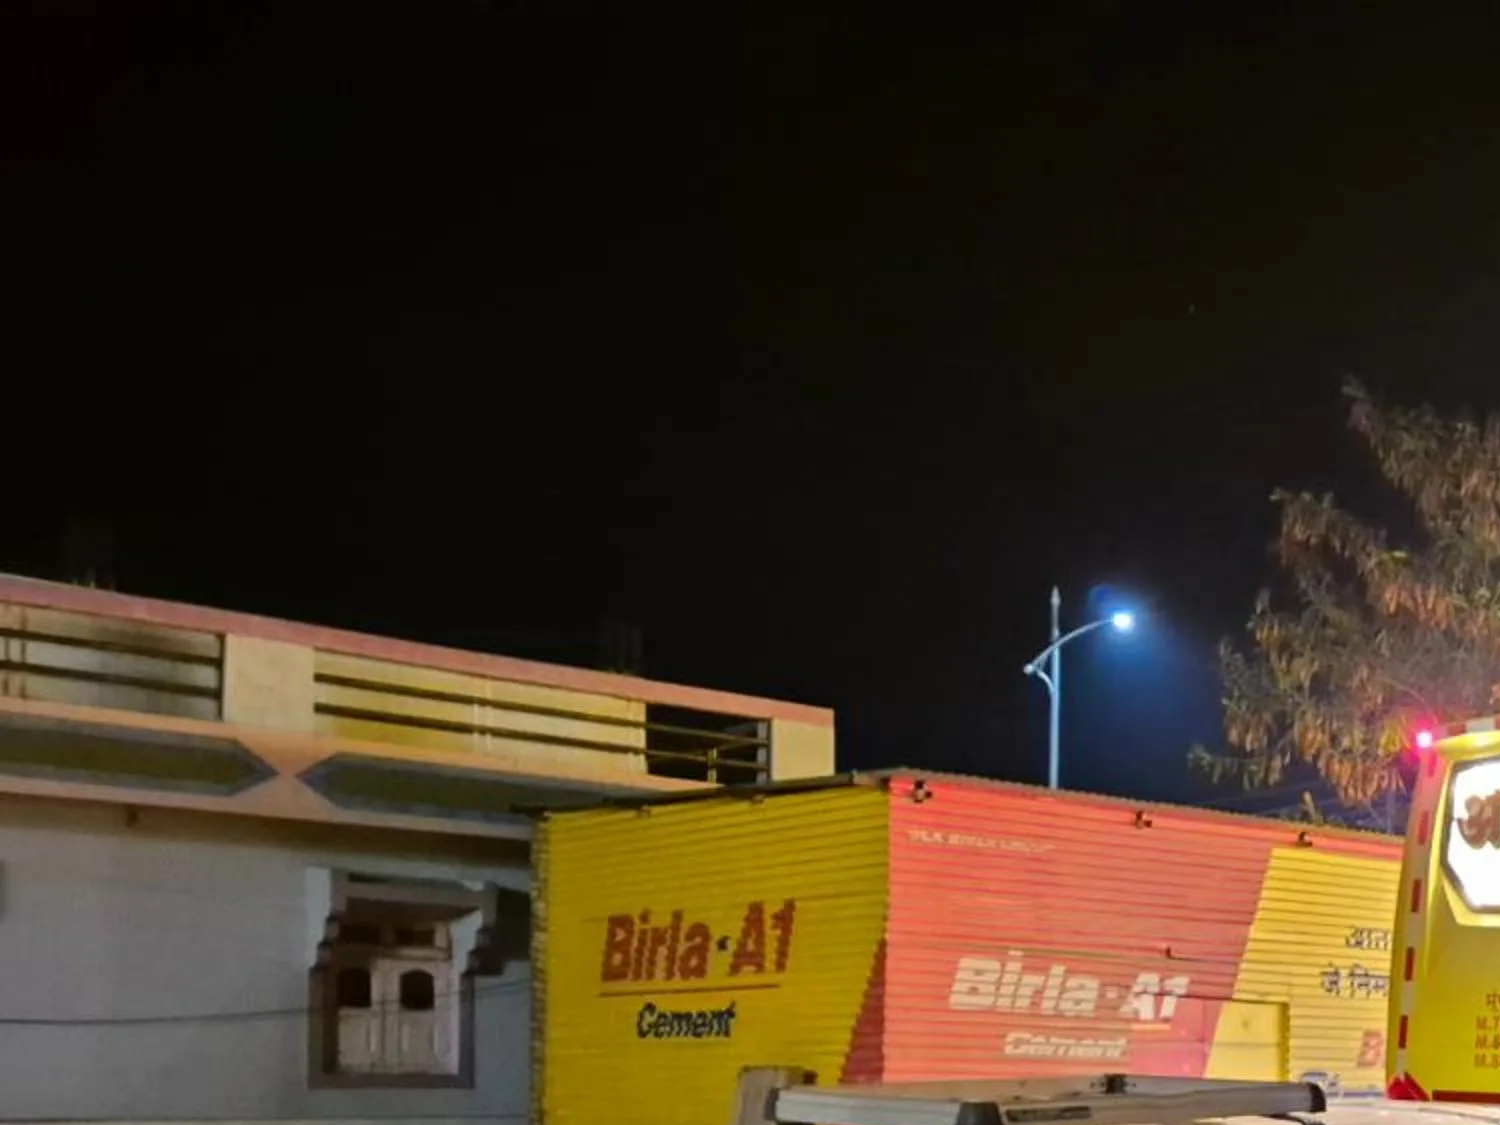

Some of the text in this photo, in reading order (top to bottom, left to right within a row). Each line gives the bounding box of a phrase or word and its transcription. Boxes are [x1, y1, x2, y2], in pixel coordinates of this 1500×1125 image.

[602, 896, 796, 983] Birla A1
[949, 949, 1190, 1021] Birla A1
[636, 1001, 736, 1039] Cement
[1004, 1032, 1127, 1057] Cement
